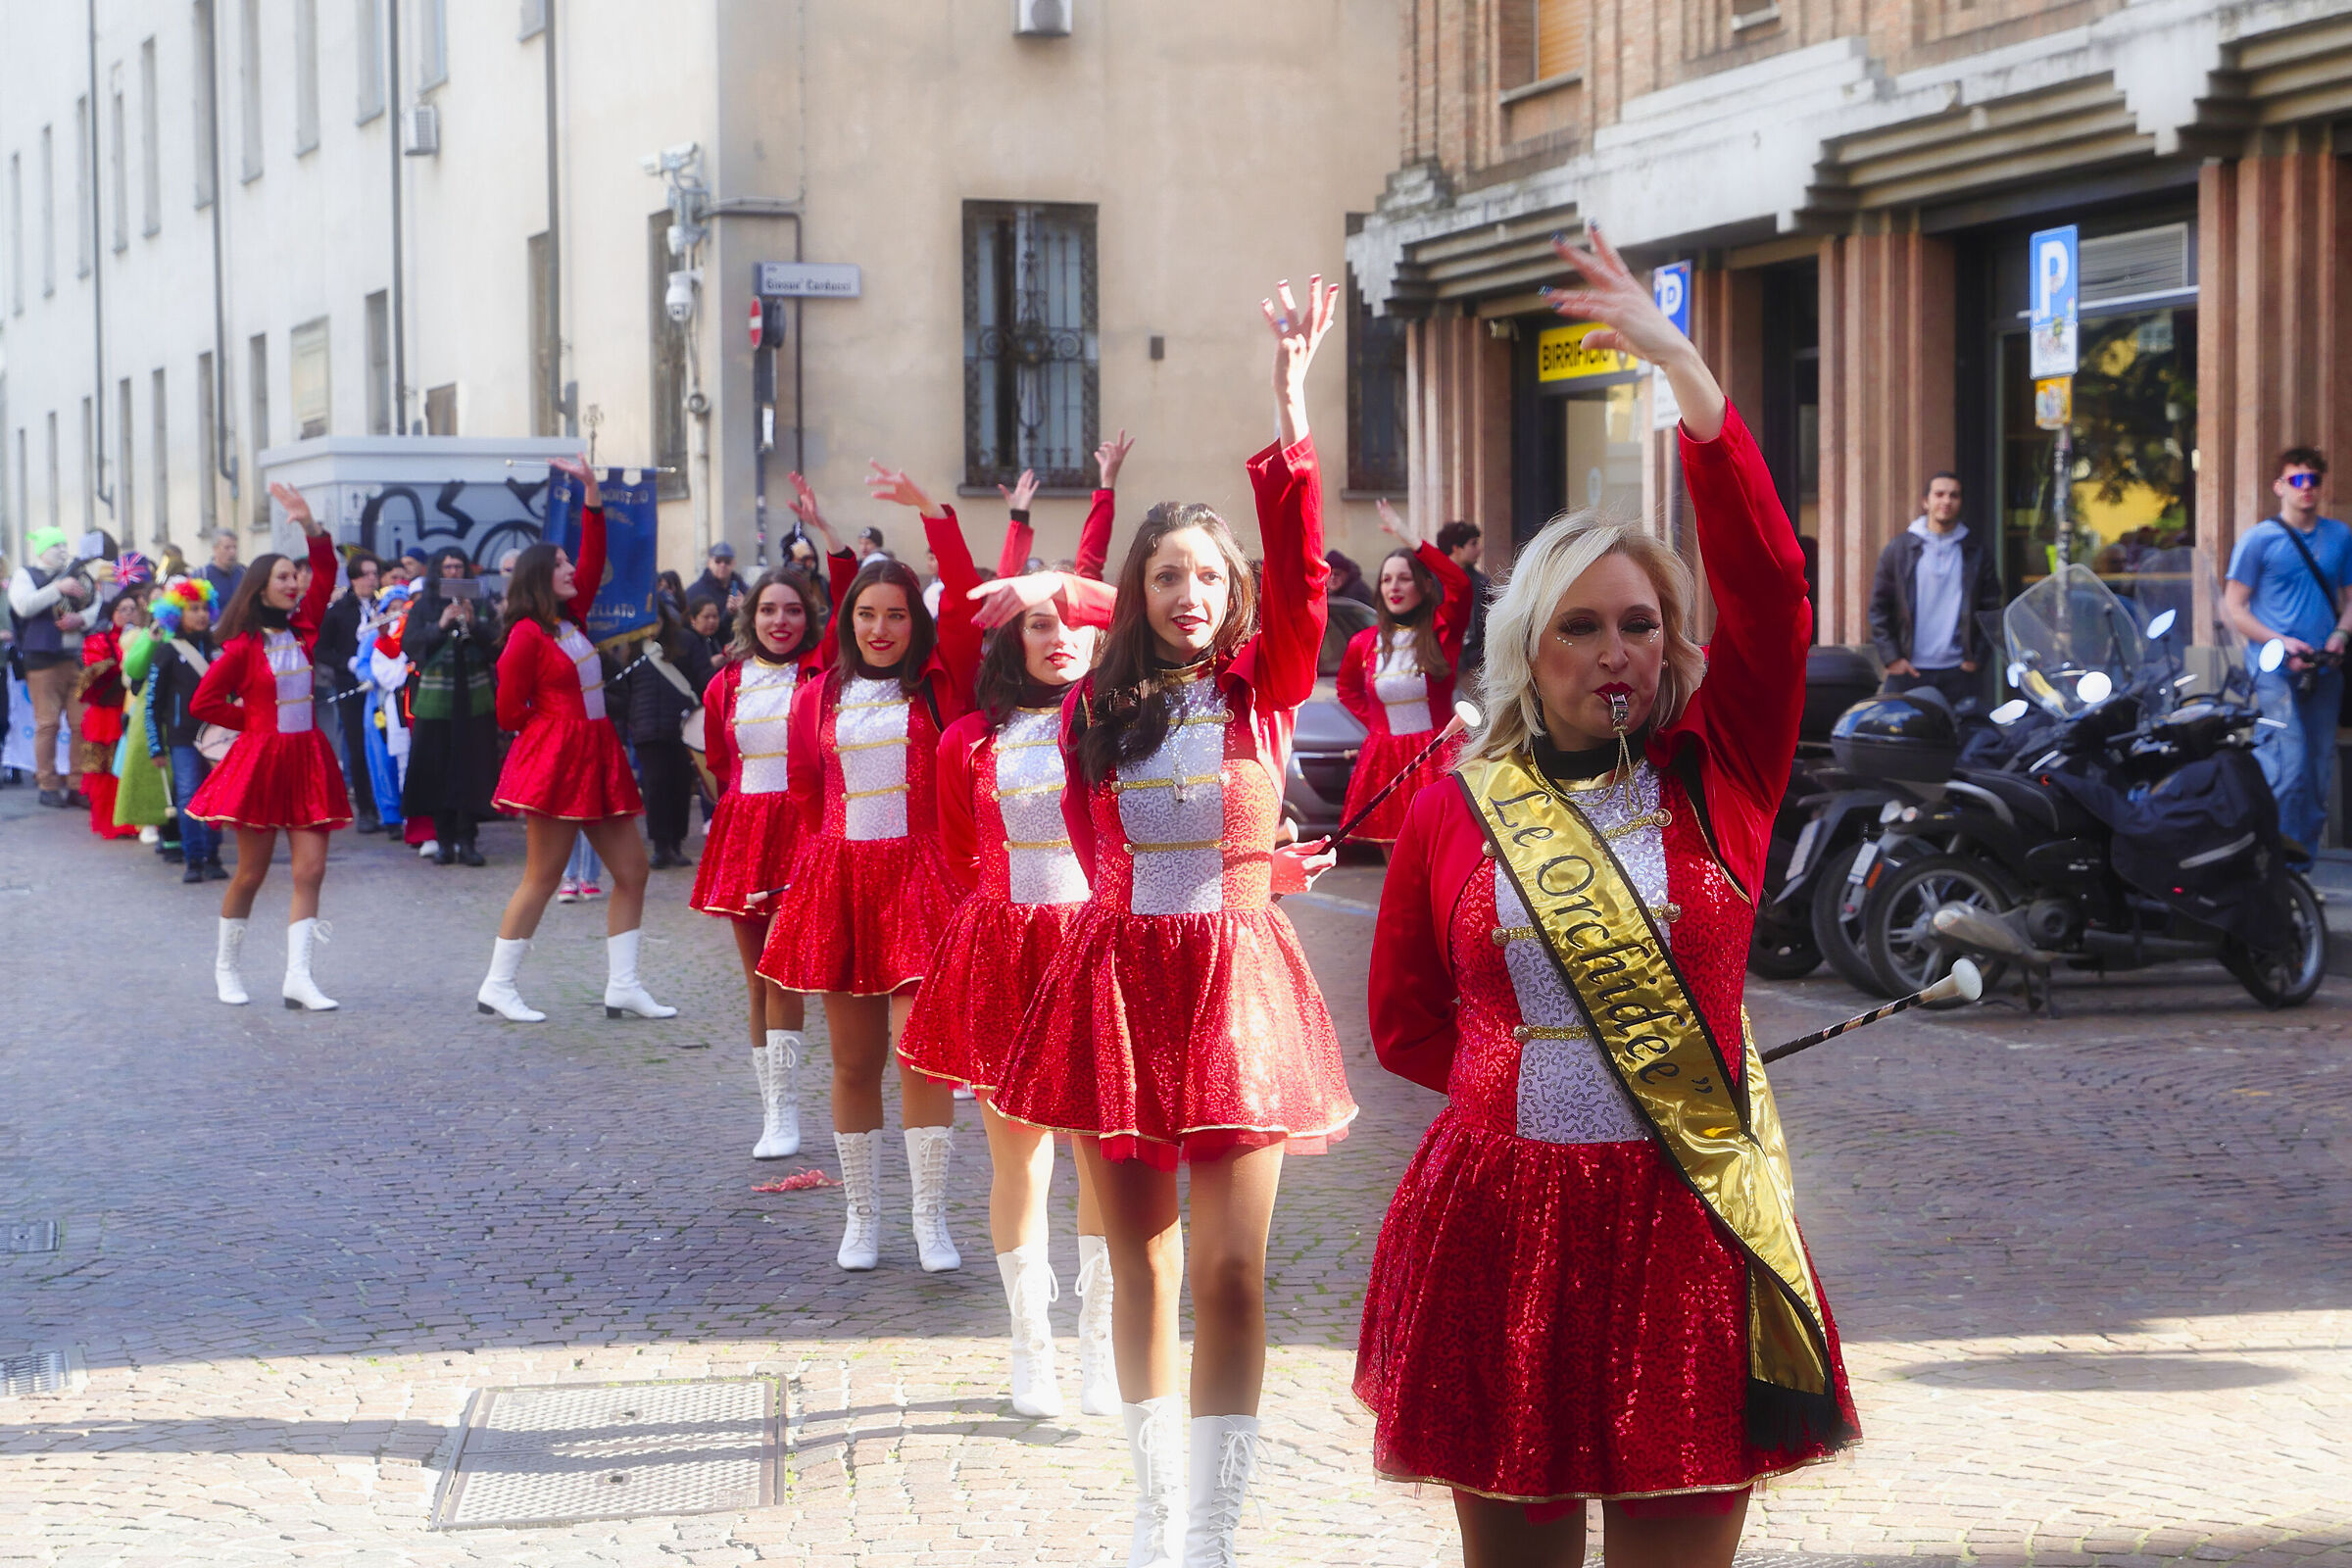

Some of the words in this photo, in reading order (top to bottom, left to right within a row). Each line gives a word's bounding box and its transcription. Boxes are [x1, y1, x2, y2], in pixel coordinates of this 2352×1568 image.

[1660, 273, 1683, 317] P
[2039, 240, 2069, 318] P
[1488, 790, 1554, 848] Le
